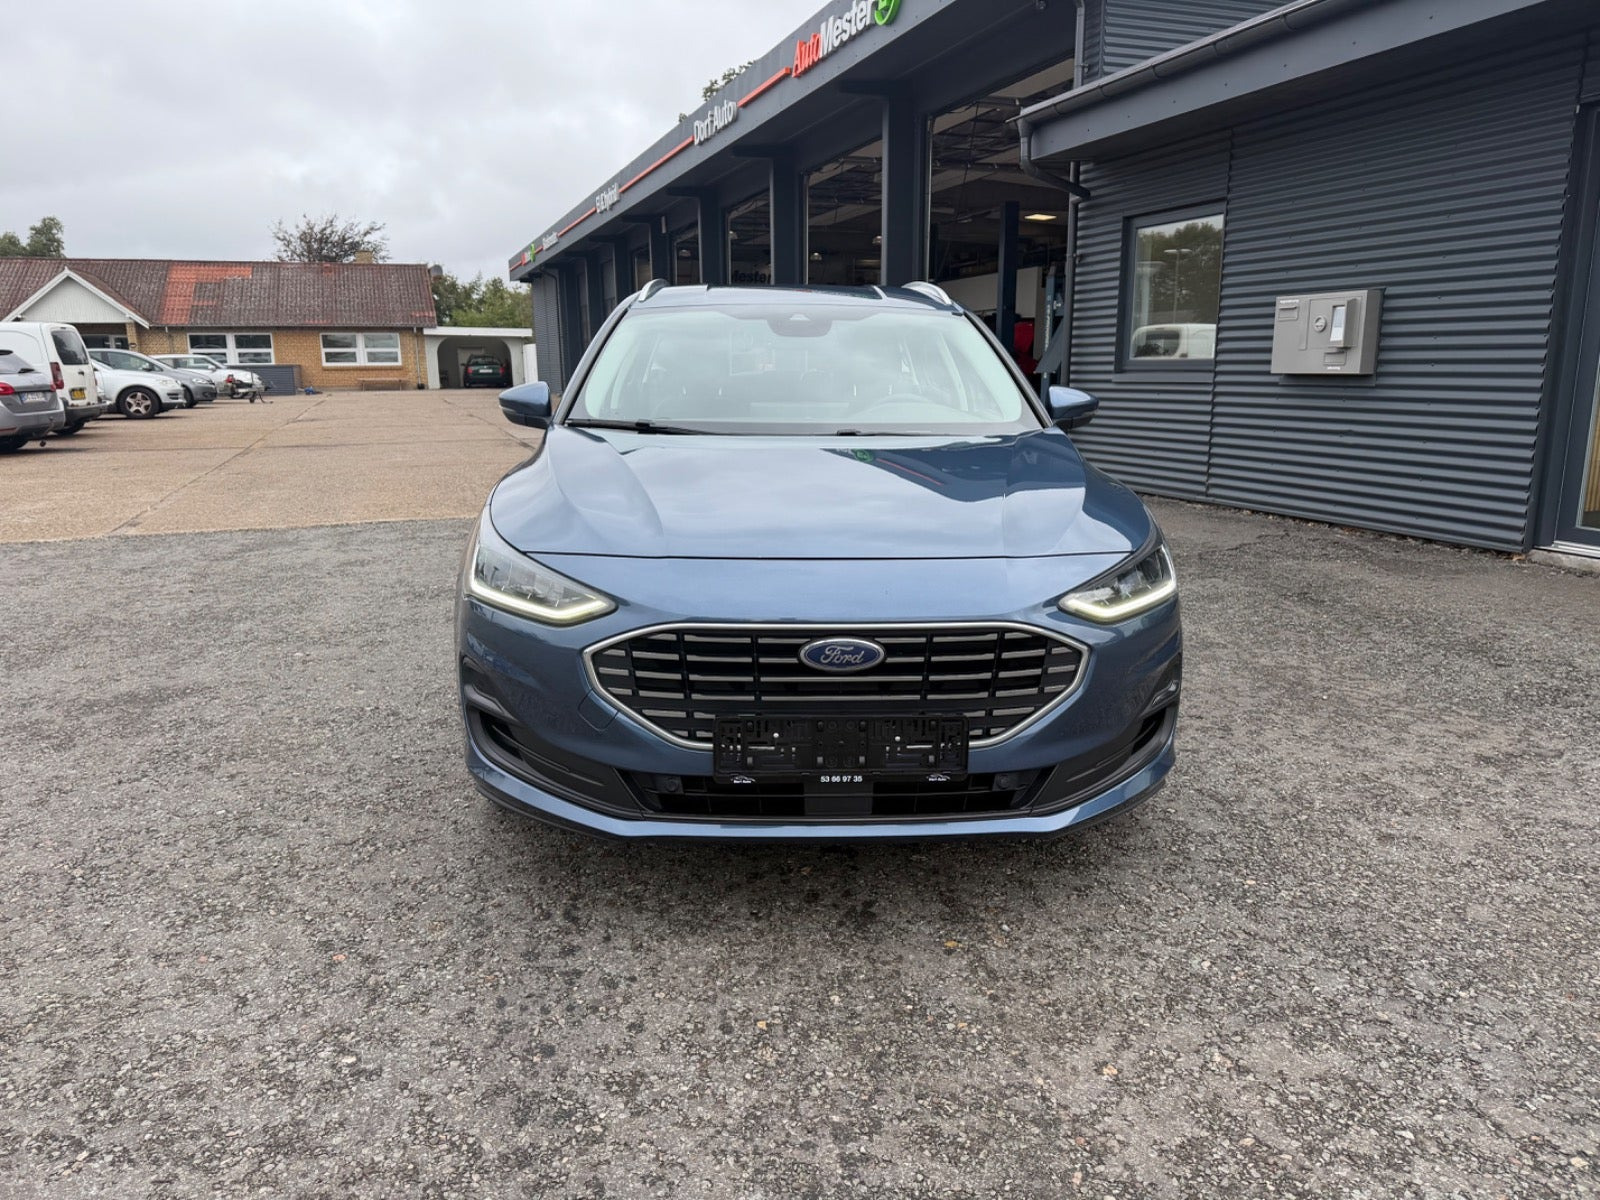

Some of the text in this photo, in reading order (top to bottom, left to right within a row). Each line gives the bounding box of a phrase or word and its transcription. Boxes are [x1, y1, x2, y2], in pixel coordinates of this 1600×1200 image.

[792, 0, 876, 77] AutoMester
[713, 99, 738, 133] Auto
[820, 645, 865, 664] Ford
[820, 775, 830, 783] 53
[842, 775, 852, 783] 97
